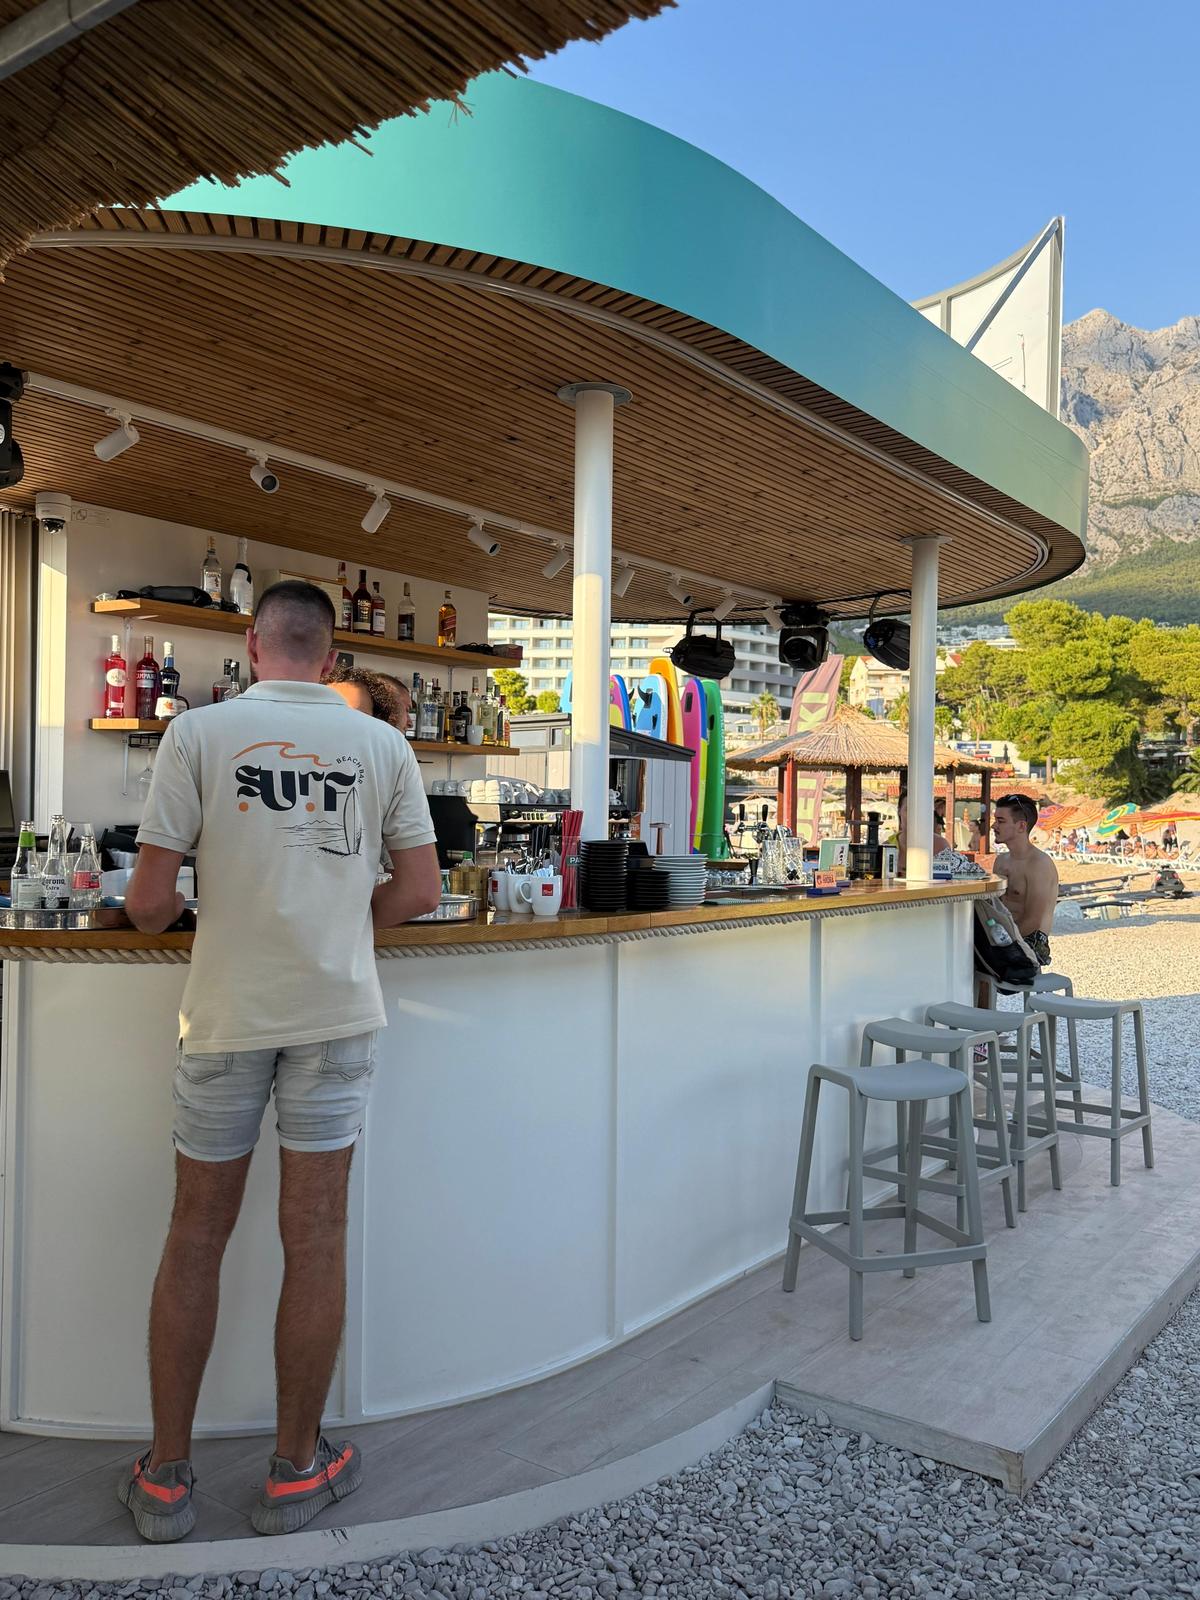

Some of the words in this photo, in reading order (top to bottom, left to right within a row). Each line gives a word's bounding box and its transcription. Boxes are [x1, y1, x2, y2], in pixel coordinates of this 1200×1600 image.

[797, 692, 829, 732] KI
[335, 755, 361, 769] BEACH
[569, 856, 581, 865] PA
